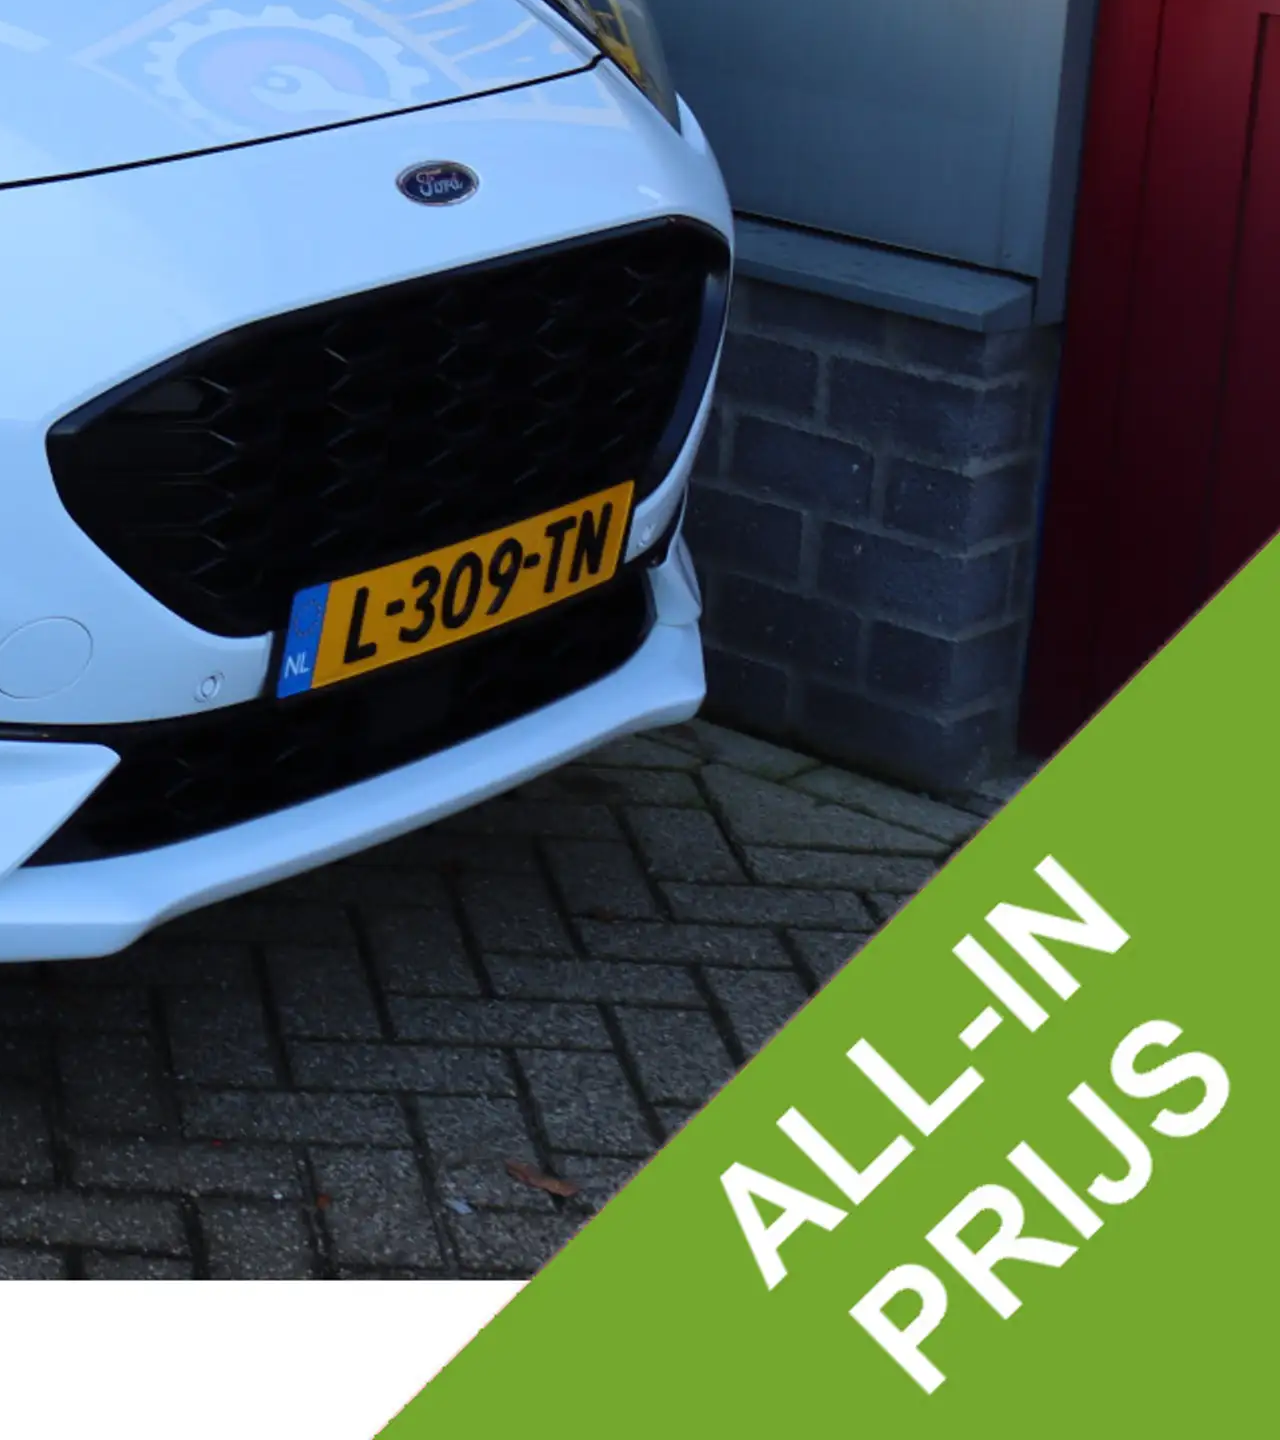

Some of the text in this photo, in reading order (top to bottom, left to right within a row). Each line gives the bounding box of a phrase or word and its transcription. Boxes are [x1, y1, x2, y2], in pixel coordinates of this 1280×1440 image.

[415, 168, 464, 197] Ford
[342, 500, 613, 665] L-309-TN
[284, 651, 310, 679] NL
